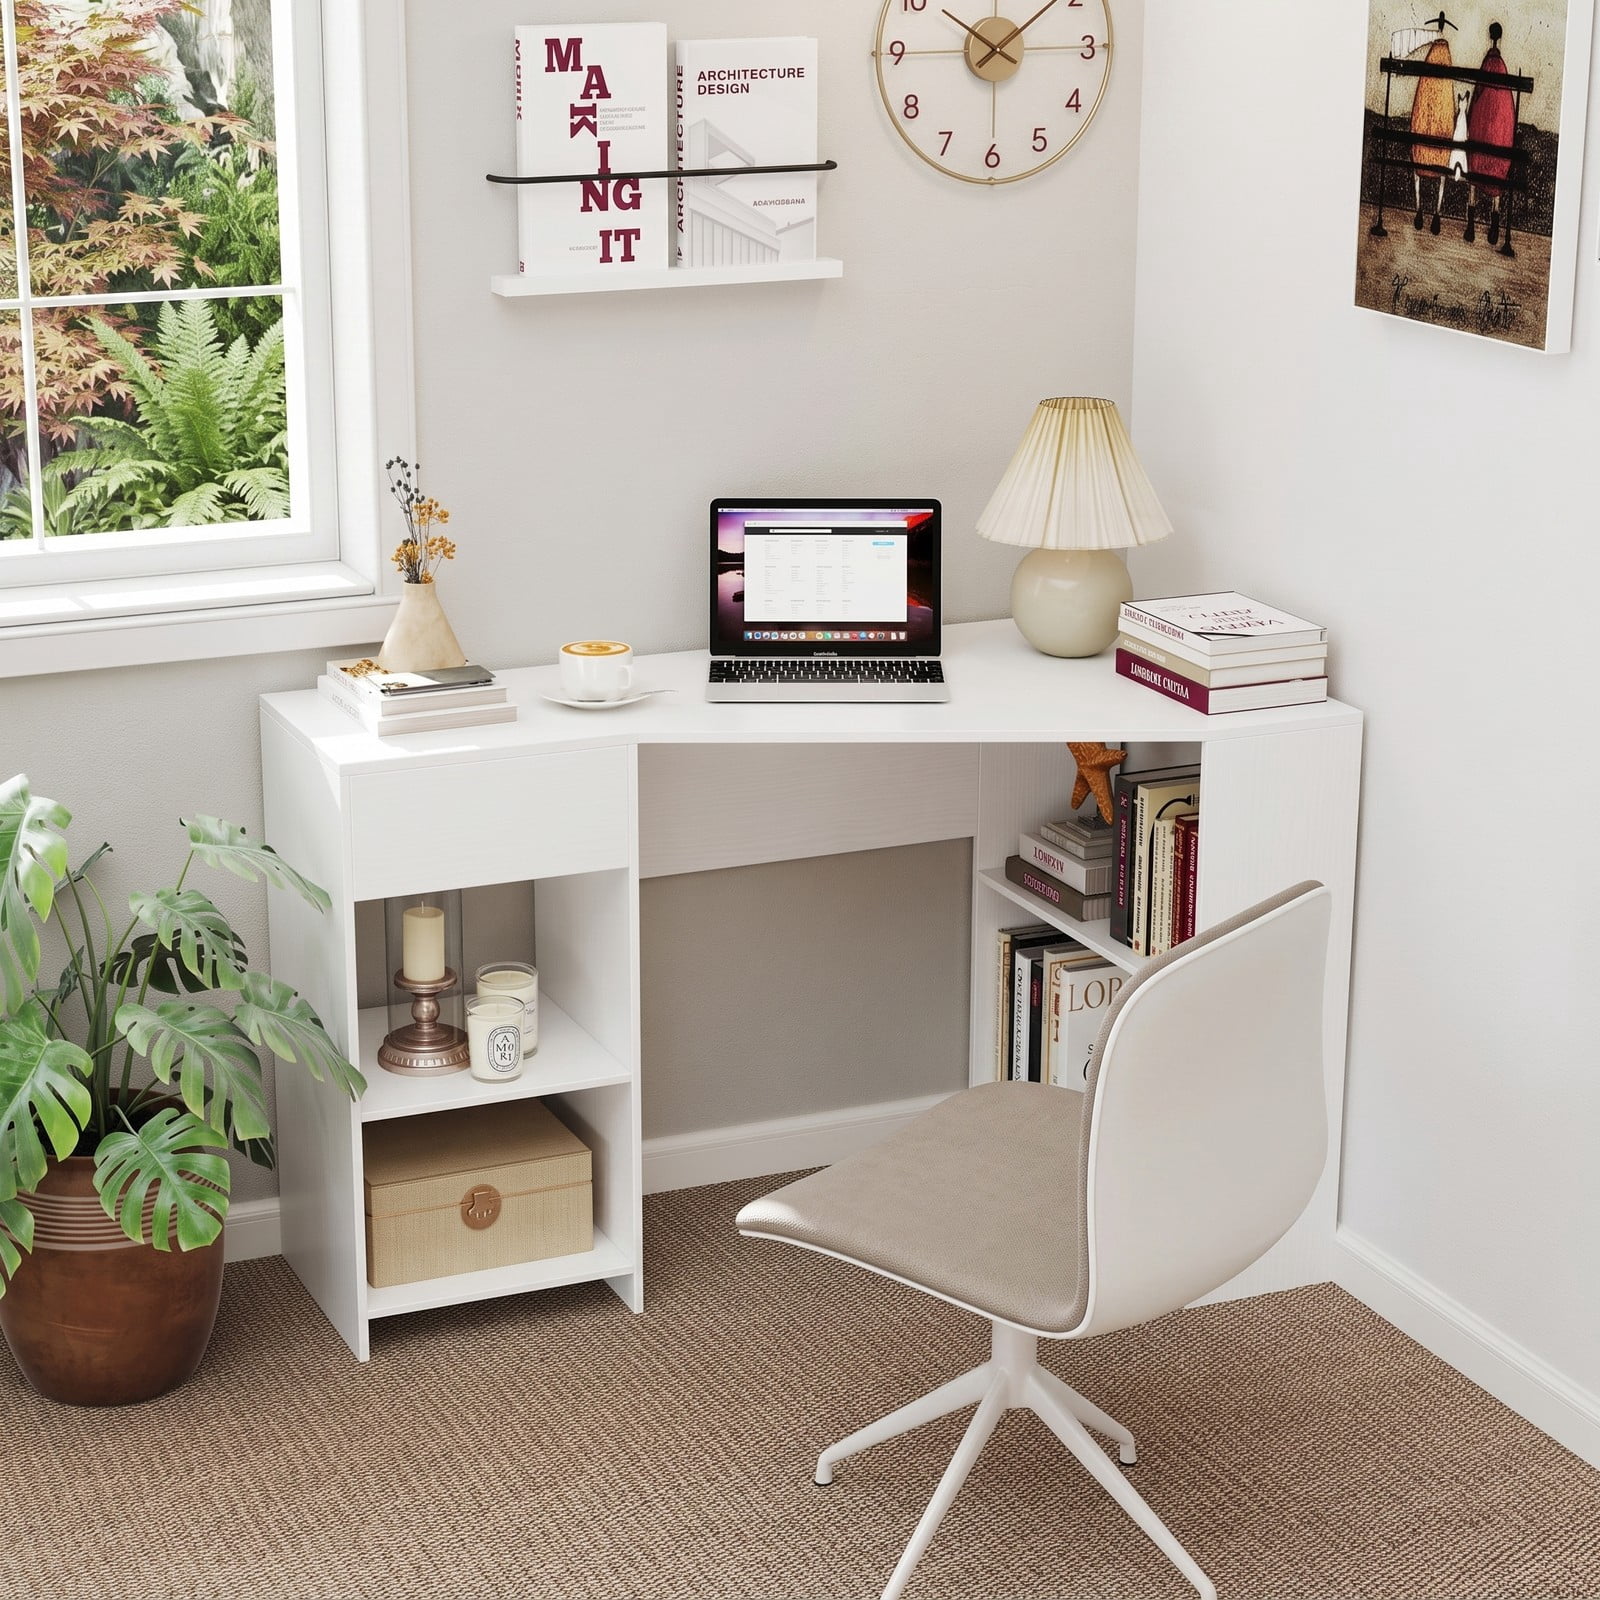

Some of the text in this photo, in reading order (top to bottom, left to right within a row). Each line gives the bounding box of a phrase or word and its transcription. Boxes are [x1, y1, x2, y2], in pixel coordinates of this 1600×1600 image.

[889, 41, 906, 65] 9
[1080, 35, 1096, 60] 3
[697, 67, 805, 82] ARCHITECTURE
[697, 83, 750, 96] DESIGN
[1065, 88, 1082, 113] 4
[903, 94, 919, 119] 8
[938, 131, 953, 156] 7
[1032, 127, 1048, 152] 5
[984, 143, 1001, 169] 6
[599, 228, 641, 263] IT
